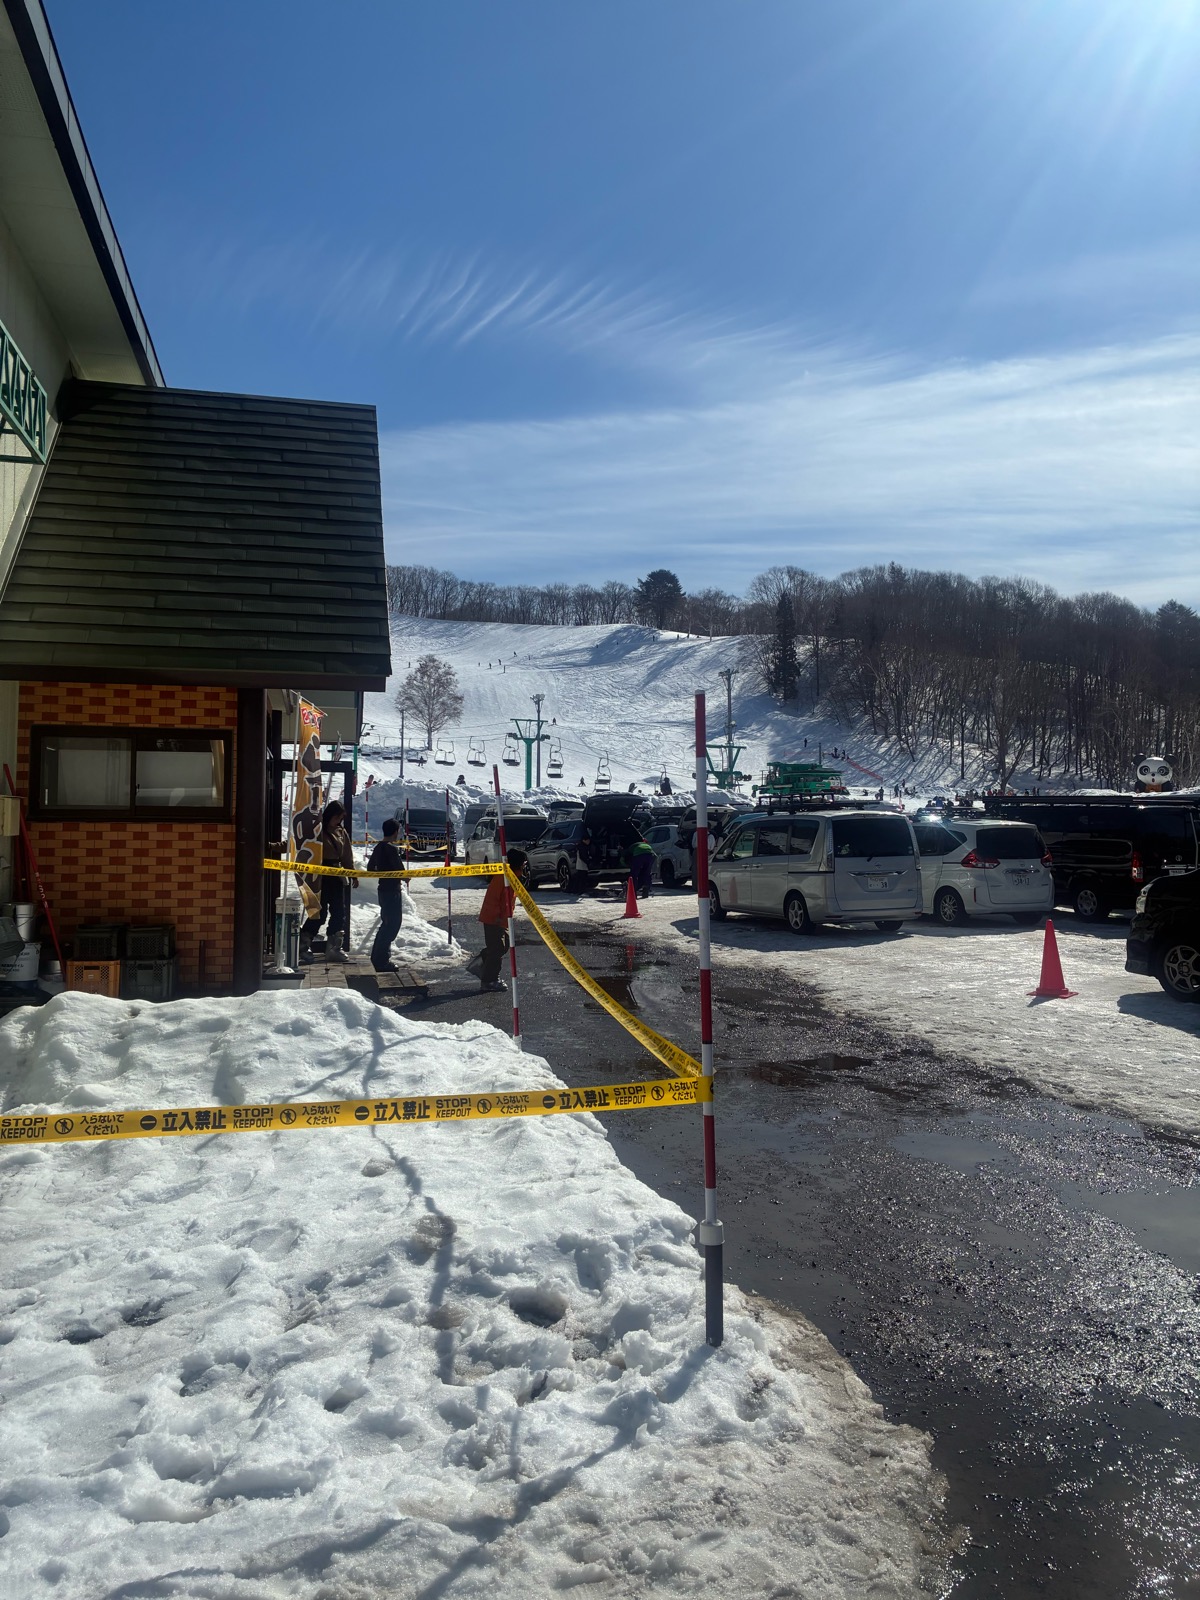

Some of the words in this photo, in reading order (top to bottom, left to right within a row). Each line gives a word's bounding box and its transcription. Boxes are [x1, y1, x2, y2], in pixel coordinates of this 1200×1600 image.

[613, 1085, 646, 1096] STOP!
[668, 1080, 699, 1092] 入らないで
[496, 1094, 530, 1104] 入らないで
[558, 1088, 610, 1110] 立入禁止
[671, 1091, 697, 1102] ください
[436, 1097, 472, 1109] STOP!
[500, 1103, 528, 1115] ください
[233, 1107, 274, 1118] STOP!
[302, 1104, 341, 1116] 入らないで
[373, 1101, 431, 1122] 立入禁止
[1, 1117, 49, 1127] STOP!
[80, 1114, 125, 1125] 入らないで
[162, 1109, 227, 1132] 立入禁止
[305, 1114, 337, 1126] ください
[84, 1124, 120, 1136] ください
